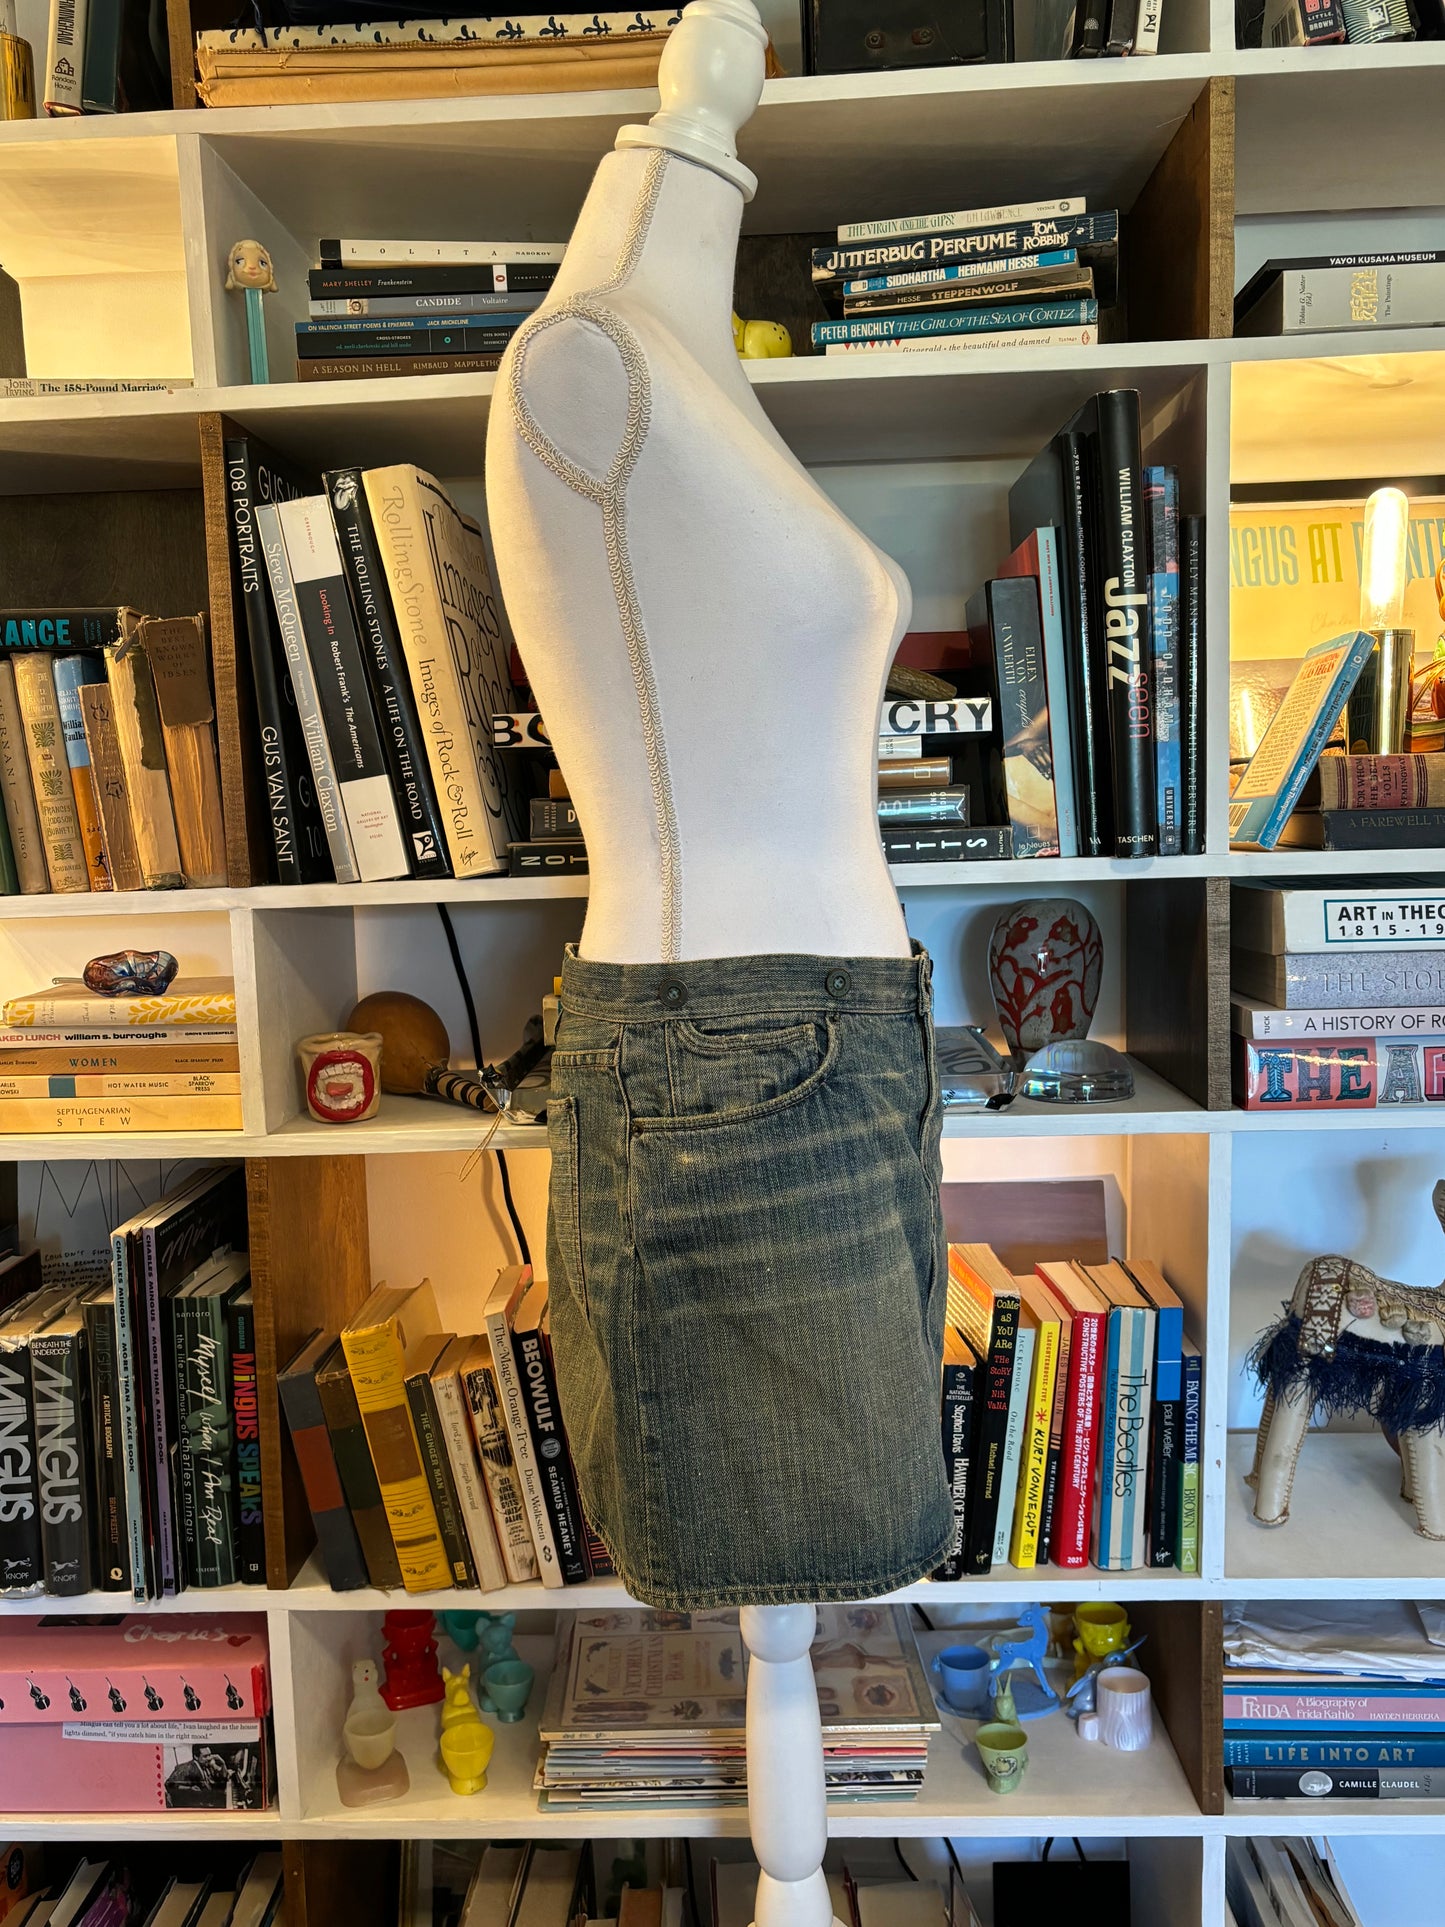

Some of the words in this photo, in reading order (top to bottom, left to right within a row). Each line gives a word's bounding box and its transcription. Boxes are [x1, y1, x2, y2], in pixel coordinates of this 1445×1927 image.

[1307, 11, 1334, 21] LITTLE,
[1309, 20, 1334, 31] BROWN
[52, 75, 77, 86] Random
[54, 82, 73, 92] House
[1023, 231, 1070, 250] ROBBINS
[1032, 220, 1058, 236] TOM
[826, 240, 926, 271] JITTERBUG
[930, 230, 1017, 259] PERFUME
[1329, 256, 1356, 266] YAYOI
[1358, 254, 1396, 265] KUSAMA
[1397, 253, 1436, 263] MUSEUM
[886, 268, 947, 288] SIDDHARTHA
[957, 259, 1007, 278] HERMANN
[1008, 254, 1040, 270] HESSE
[322, 280, 343, 288] MARY
[344, 279, 373, 288] SHELLEY
[377, 278, 413, 287] Frankenstein
[931, 282, 1019, 300] STEPPENWOLF
[1384, 273, 1392, 303] Paintings
[415, 297, 462, 308] CANDIDE
[481, 297, 509, 305] Voltaire
[897, 295, 921, 303] HESSE
[343, 322, 362, 330] STREET
[820, 324, 848, 340] PETER
[850, 320, 896, 338] BENCHLEY
[962, 339, 1000, 351] beautiful
[1018, 335, 1051, 346] damned
[321, 364, 359, 375] SEASON
[361, 363, 373, 373] IN
[375, 362, 402, 373] HELL
[413, 361, 449, 370] RIMBAUD
[5, 385, 35, 397] IRVING
[9, 379, 32, 389] JOHN
[40, 383, 61, 393] The
[64, 382, 119, 393] 158-Pound
[228, 458, 248, 493] 108
[1118, 467, 1133, 526] WILLIAM
[234, 497, 259, 594] PORTRAITS
[347, 523, 363, 553] THE
[1307, 522, 1344, 584] AT
[1121, 526, 1136, 588] CLAXTON
[1189, 539, 1200, 581] SALLY
[353, 555, 379, 617] ROLLING
[266, 543, 285, 585] Steve
[276, 587, 301, 663] McQueen
[319, 588, 333, 626] Looking
[1190, 586, 1200, 626] MANN
[0, 619, 72, 647] ANCE
[366, 617, 390, 671] STONES
[1103, 576, 1149, 691] Jazz
[329, 640, 345, 673] Robert
[348, 723, 365, 769] Americans
[386, 697, 401, 725] LIFE
[1126, 671, 1151, 740] seen
[261, 726, 282, 767] GUS
[393, 726, 408, 753] ON
[418, 657, 442, 718] Images
[436, 735, 456, 782] Rock
[451, 804, 475, 841] Roll
[303, 713, 324, 772] William
[316, 775, 339, 833] Claxton
[399, 750, 414, 780] THE
[1355, 757, 1365, 791] WHOM
[267, 770, 288, 811] VAN
[1382, 765, 1392, 799] TOLLS
[1399, 756, 1409, 808] HEMINGWAY
[405, 782, 423, 821] ROAD
[1165, 788, 1174, 831] UNIVERSE
[1187, 767, 1198, 835] APERTURE
[1361, 814, 1431, 828] FAREWELL
[17, 827, 28, 860] HUGO
[273, 816, 295, 865] SANT
[1117, 835, 1155, 844] TASCHEN
[1338, 905, 1377, 922] ART
[1381, 911, 1394, 921] IN
[1318, 972, 1372, 993] THE
[24, 1033, 61, 1042] LUNCH
[64, 1032, 101, 1041] william
[113, 1031, 168, 1042] burroughs
[1263, 1015, 1271, 1035] TUCK
[1304, 1017, 1317, 1032] A
[1322, 1015, 1396, 1031] HISTORY
[1401, 1014, 1426, 1029] OF
[68, 1057, 118, 1068] WOMEN
[1257, 1046, 1372, 1103] THE
[123, 1081, 147, 1089] WATER
[148, 1081, 169, 1089] MUSIC
[56, 1106, 131, 1117] SEPTUAGENARIAN
[56, 1116, 132, 1127] STEW
[115, 1240, 123, 1284] CHARLES
[118, 1287, 126, 1329] MINGUS
[31, 1340, 57, 1349] BENEATH
[32, 1347, 71, 1357] UNDERDOG
[121, 1343, 130, 1372] MORE
[1018, 1335, 1026, 1355] JACK
[1059, 1336, 1070, 1369] JAMES
[1079, 1317, 1090, 1373] CONSTRUCTIVE
[186, 1333, 222, 1406] Myself
[521, 1338, 555, 1434] BEOWULF
[1055, 1369, 1068, 1415] BALDWIN
[1077, 1372, 1087, 1408] POSTERS
[1118, 1368, 1150, 1414] The
[1185, 1379, 1200, 1421] FACING
[33, 1356, 83, 1526] MINGUS
[425, 1428, 437, 1468] GINGER
[499, 1347, 515, 1388] Magic
[507, 1387, 524, 1432] Orange
[523, 1468, 536, 1493] Diane
[530, 1495, 546, 1541] Wolkstein
[1032, 1427, 1046, 1466] KURT
[1162, 1427, 1174, 1458] weller
[127, 1445, 135, 1473] BOOK
[1072, 1452, 1081, 1490] CENTURY
[1114, 1416, 1145, 1498] Beatles
[1184, 1445, 1198, 1480] MUSIC
[952, 1457, 970, 1500] HAMMER
[184, 1492, 195, 1543] mingus
[548, 1465, 564, 1511] SEAMUS
[557, 1511, 574, 1557] HEANEY
[1025, 1468, 1043, 1538] VONNEGUT
[1183, 1487, 1197, 1529] BROWN
[198, 1505, 223, 1546] Real
[1066, 1556, 1083, 1564] 2021
[5, 1571, 30, 1581] KNOPF
[53, 1574, 79, 1583] KNOPF
[1241, 1695, 1292, 1719] FRIDA
[1296, 1709, 1322, 1719] Frida
[1323, 1709, 1355, 1720] Kahlo
[1306, 1696, 1357, 1709] Biography
[1369, 1712, 1401, 1720] HAYDEN
[1402, 1712, 1440, 1720] HERRERA
[64, 1729, 81, 1738] lights
[128, 1731, 144, 1739] catch
[175, 1732, 190, 1741] right
[150, 1721, 167, 1729] about
[197, 1722, 221, 1732] laughed
[1265, 1746, 1310, 1761] LIFE
[1320, 1747, 1370, 1762] INTO
[1378, 1748, 1416, 1762] ART
[1339, 1780, 1378, 1789] CAMILLE
[1381, 1780, 1421, 1789] CLAUDEL
